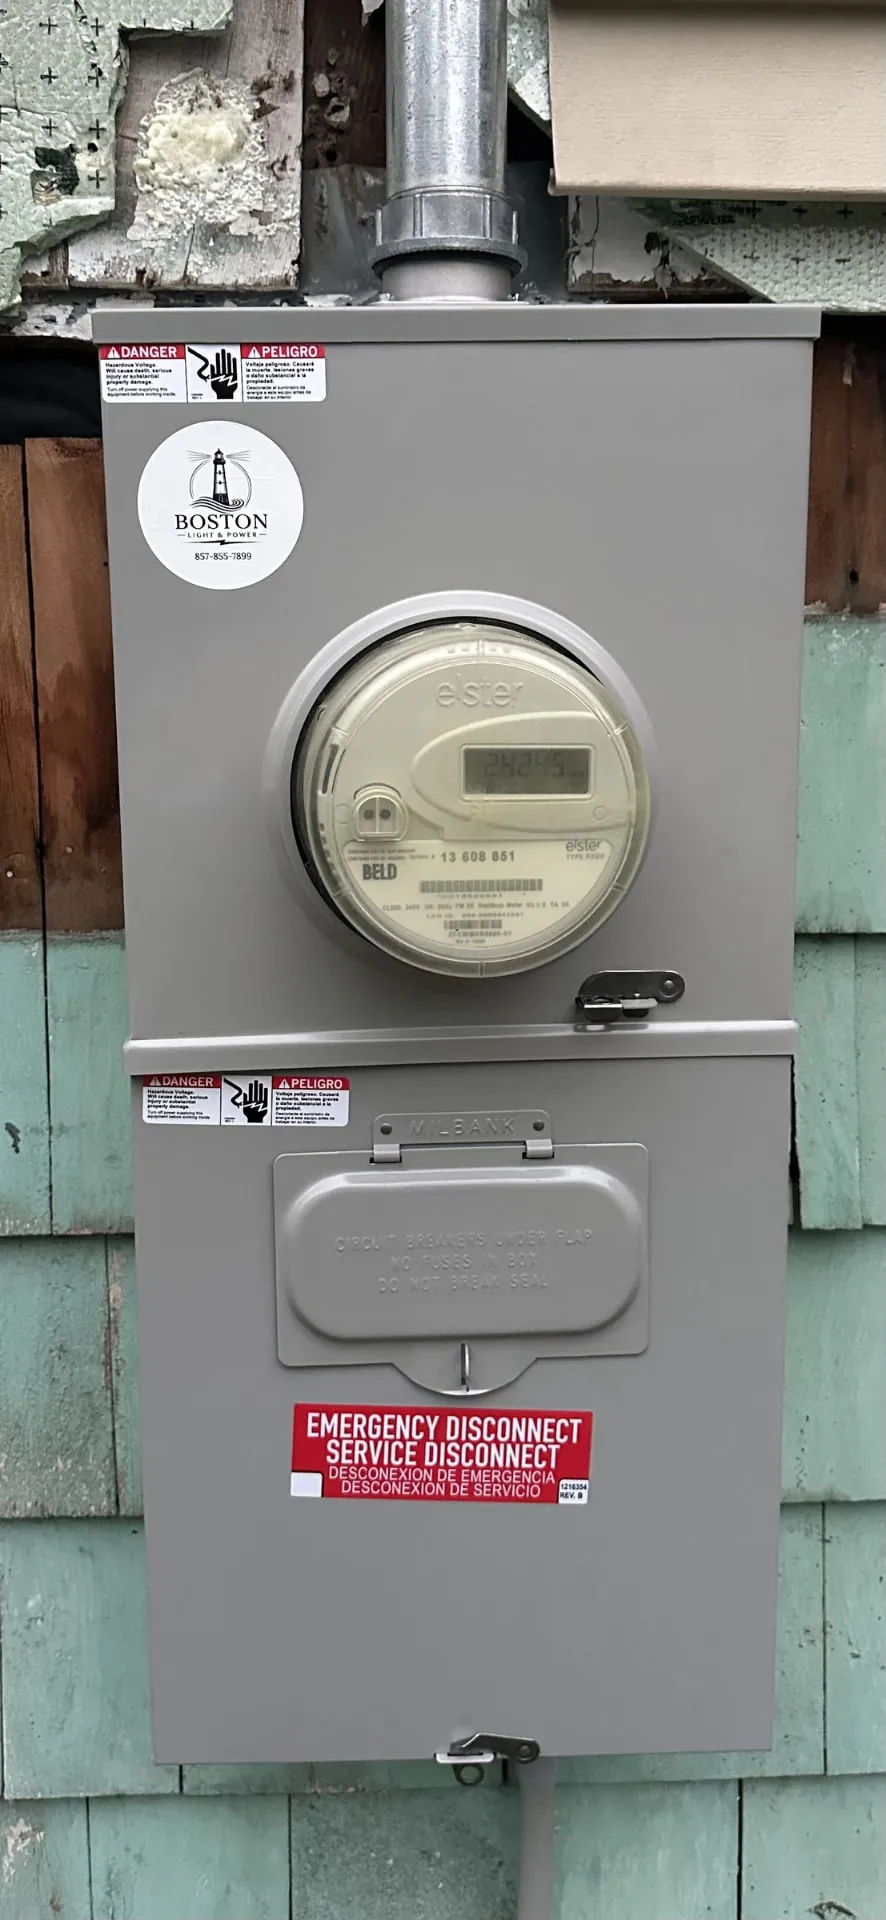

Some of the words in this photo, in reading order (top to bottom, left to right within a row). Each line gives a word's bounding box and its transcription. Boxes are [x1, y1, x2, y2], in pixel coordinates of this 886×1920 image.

[121, 346, 177, 358] DANGER
[262, 346, 318, 358] PELIGRO
[175, 513, 268, 530] BOSTON
[195, 552, 252, 561] 857-855-7899
[435, 673, 524, 708] elster
[565, 839, 601, 852] elster
[440, 852, 457, 863] 13
[462, 851, 486, 862] 608
[492, 851, 516, 862] 851
[362, 863, 398, 881] BELD
[163, 1076, 214, 1087] DANGER
[292, 1079, 343, 1089] PELIGRO
[409, 1117, 517, 1137] MILBANK
[556, 1228, 593, 1246] FLAP
[422, 1254, 472, 1271] FUSES
[508, 1252, 538, 1269] BOX
[410, 1275, 441, 1293] NOT
[451, 1274, 500, 1291] BREAK
[510, 1272, 550, 1290] SEAL
[307, 1412, 439, 1442] EMERGENCY
[446, 1416, 583, 1445] DISCONNECT
[326, 1439, 417, 1466] SERVICE
[424, 1442, 560, 1469] DISCONNECT
[329, 1465, 433, 1483] DESCONEXION
[438, 1469, 455, 1483] DE
[461, 1469, 556, 1485] EMERGENCIA
[342, 1479, 445, 1496] DESCONEXION
[451, 1482, 469, 1496] DE
[474, 1482, 541, 1498] SERVICIO
